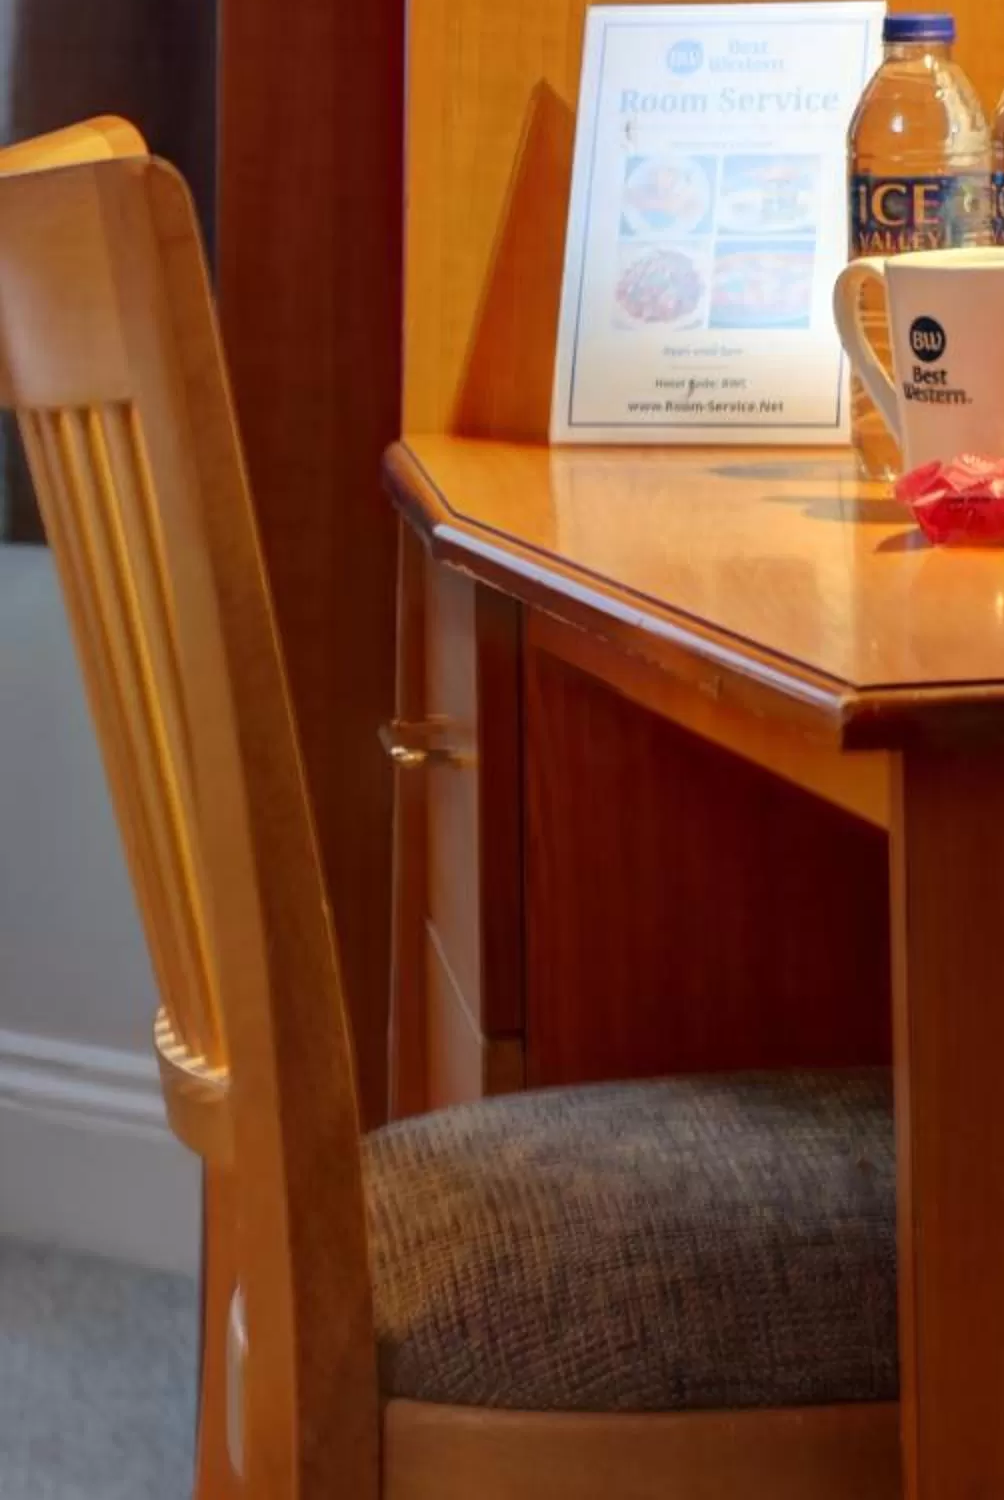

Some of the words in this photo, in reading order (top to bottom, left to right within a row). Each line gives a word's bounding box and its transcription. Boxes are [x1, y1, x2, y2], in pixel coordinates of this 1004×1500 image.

[618, 86, 708, 114] Room
[718, 85, 841, 114] Service
[858, 184, 942, 226] ICE
[858, 231, 942, 253] VALLEY
[912, 330, 943, 352] BW
[912, 365, 948, 385] Best
